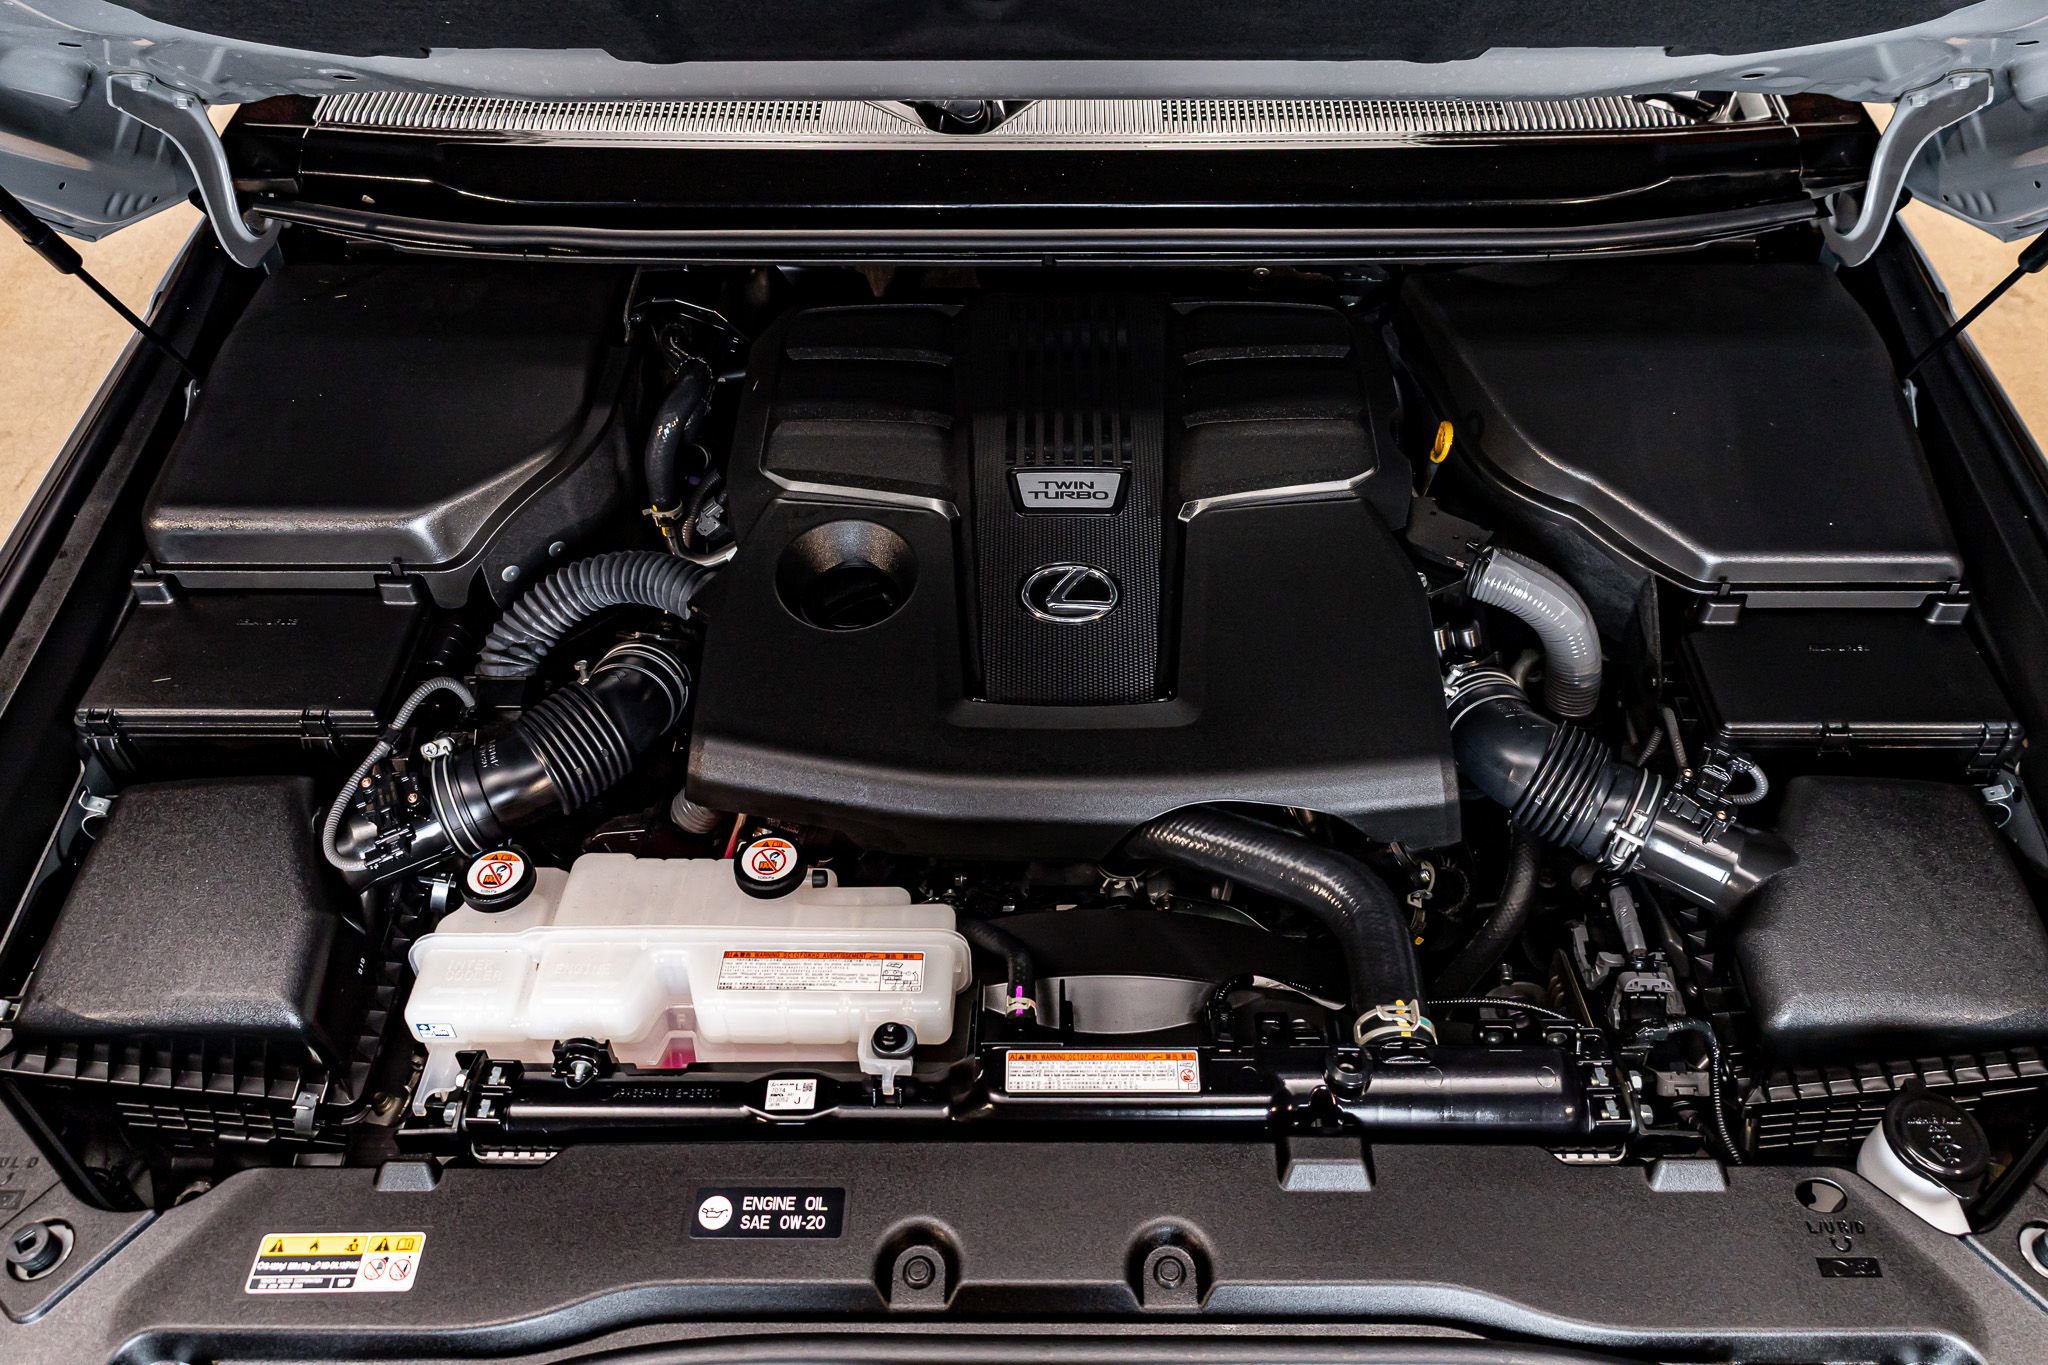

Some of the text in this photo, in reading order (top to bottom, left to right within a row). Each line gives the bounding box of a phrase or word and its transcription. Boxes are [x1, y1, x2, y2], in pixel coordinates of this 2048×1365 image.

[1038, 481, 1095, 490] TWIN
[1028, 491, 1109, 500] TURBO
[743, 1196, 828, 1211] ENGINE OIL
[740, 1215, 826, 1230] SAE 0W-20
